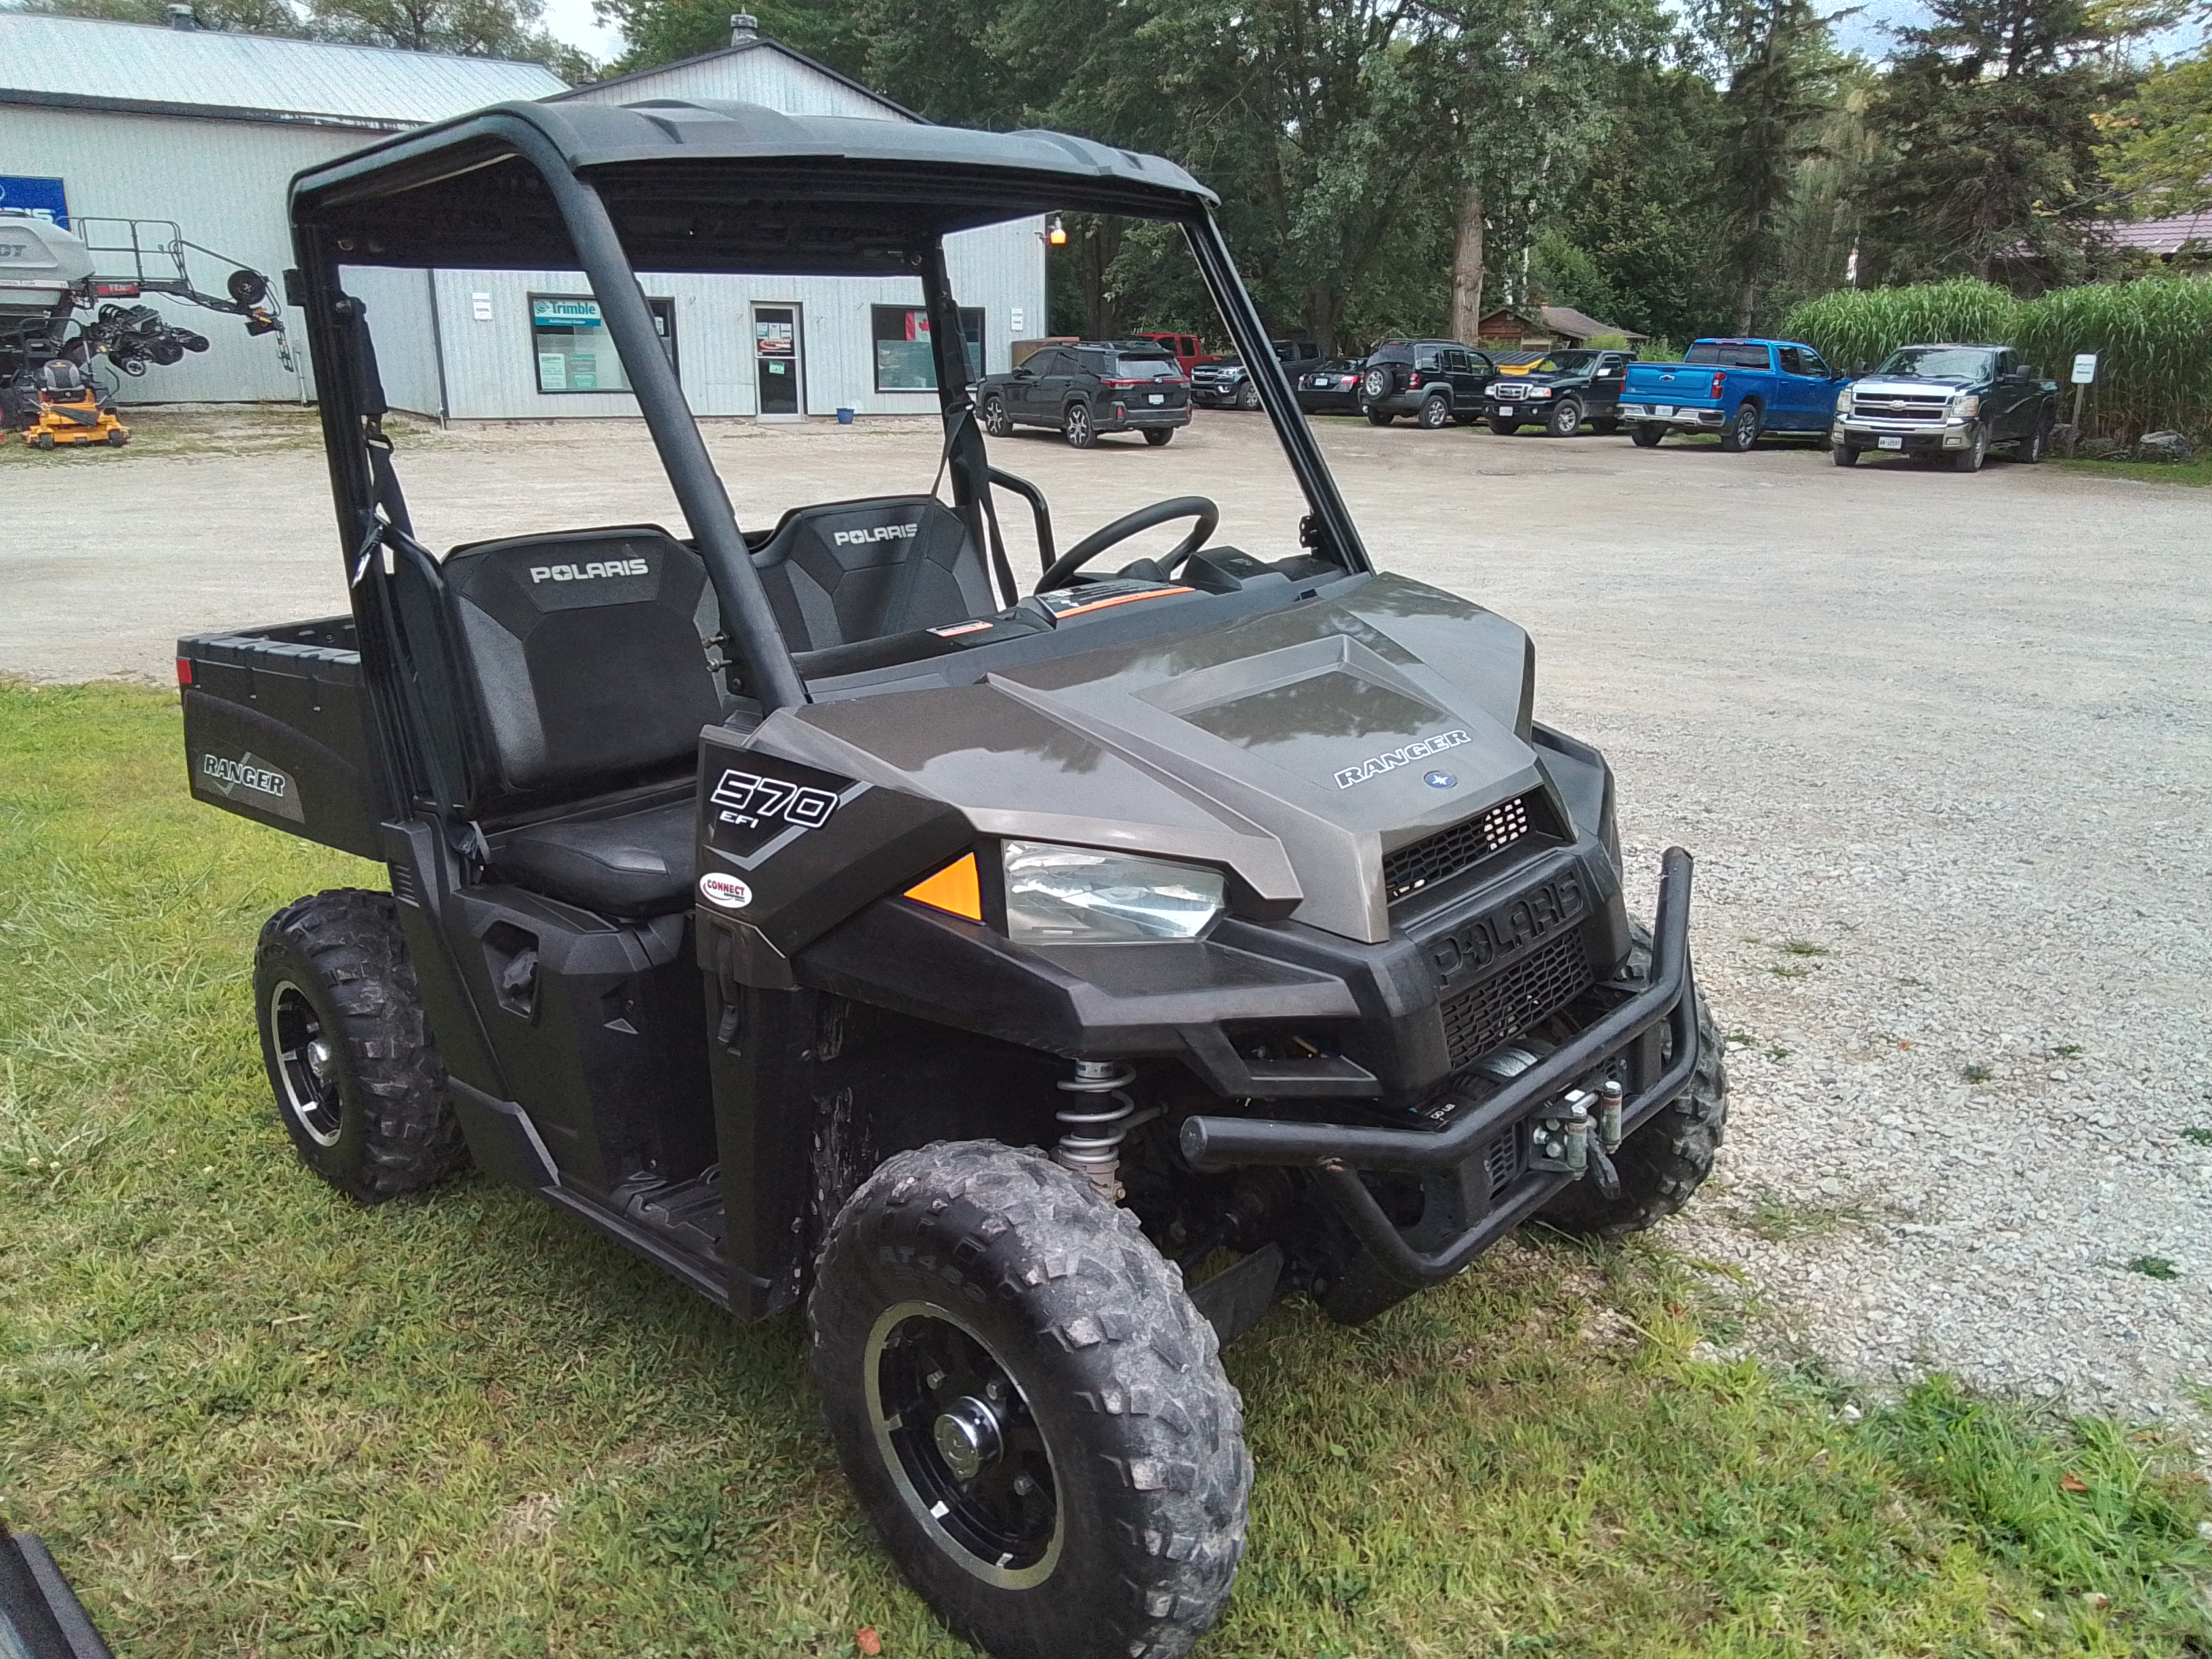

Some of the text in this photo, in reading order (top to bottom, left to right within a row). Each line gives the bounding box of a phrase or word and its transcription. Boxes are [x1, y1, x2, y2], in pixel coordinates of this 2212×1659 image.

[550, 300, 596, 315] Trimble
[833, 523, 918, 546] POLARIS
[530, 558, 649, 583] POLARIS
[1334, 730, 1472, 790] RANGER
[204, 754, 286, 797] RANGER
[710, 769, 838, 828] 570
[720, 811, 759, 828] EFI
[707, 879, 745, 896] CONNECT
[1426, 870, 1584, 991] POLARIS
